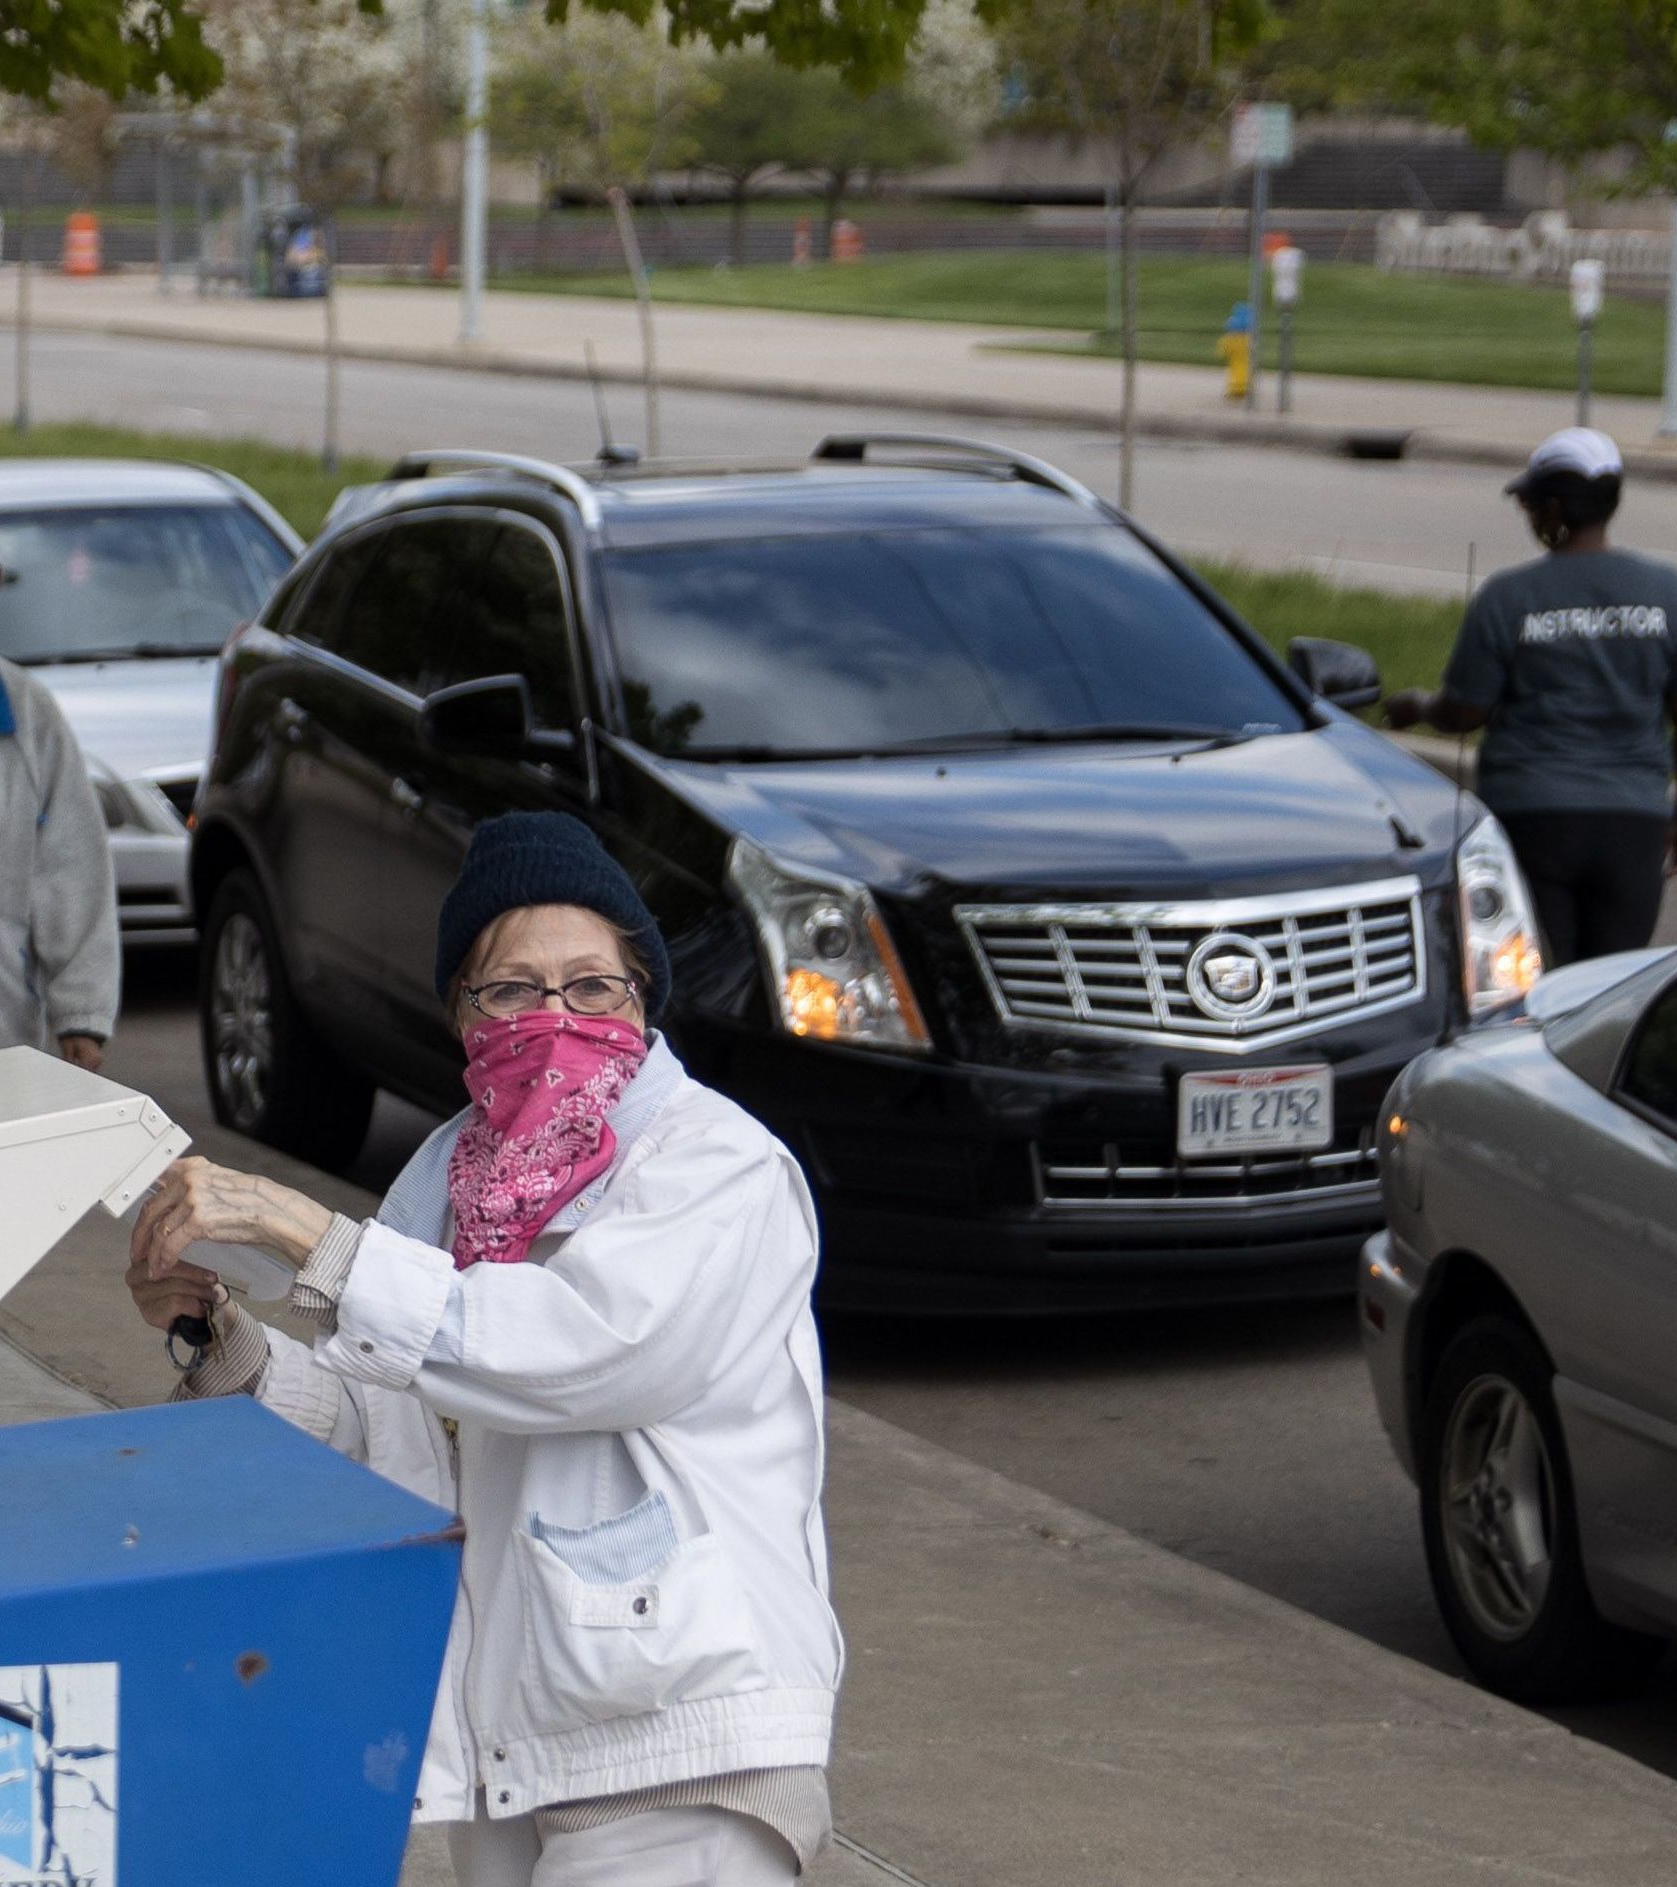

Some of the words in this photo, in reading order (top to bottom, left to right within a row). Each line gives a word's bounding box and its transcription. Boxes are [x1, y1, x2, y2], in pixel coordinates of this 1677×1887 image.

[1520, 605, 1668, 643] INSTRUCTOR
[1190, 1091, 1242, 1135] HVE
[1250, 1086, 1321, 1131] 2752
